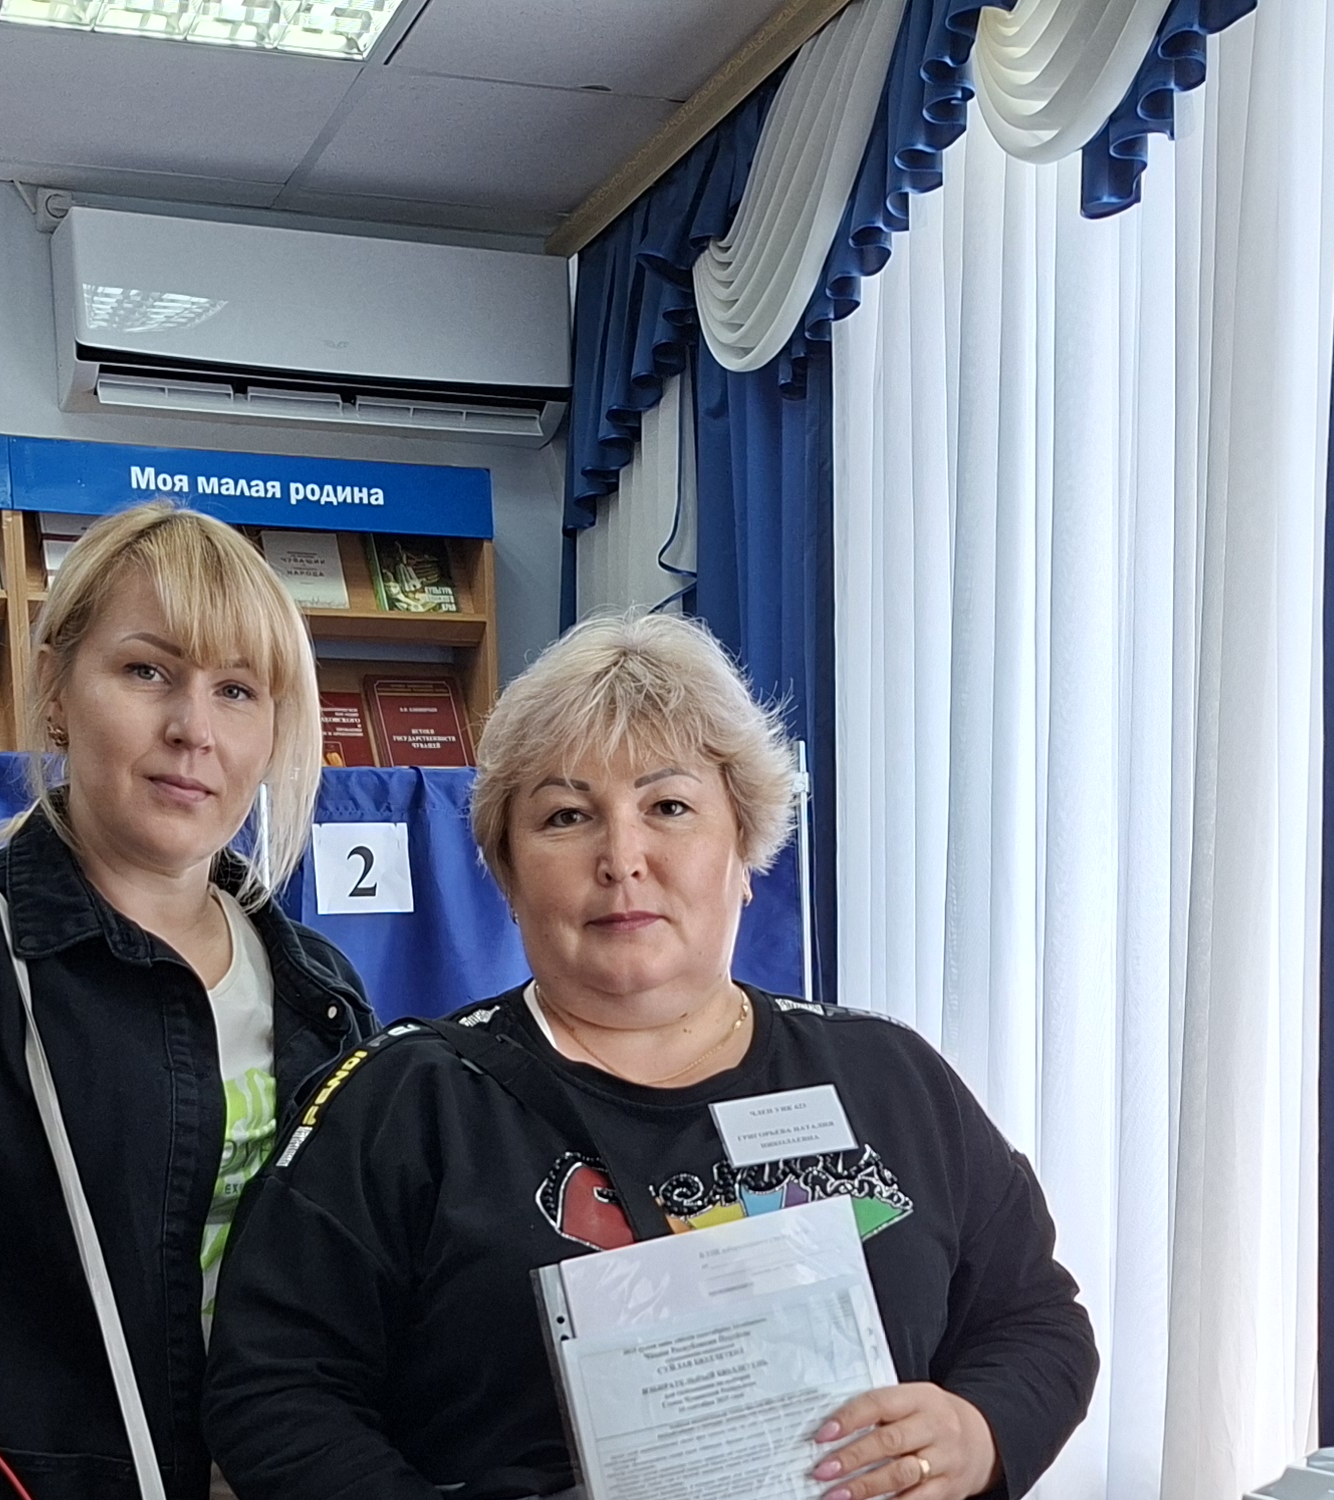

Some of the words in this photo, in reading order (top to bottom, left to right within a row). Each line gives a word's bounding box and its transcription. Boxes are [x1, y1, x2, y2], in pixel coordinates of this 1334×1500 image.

[129, 465, 190, 494] Моя
[197, 474, 281, 499] малая
[289, 480, 385, 507] родина
[346, 845, 378, 897] 2
